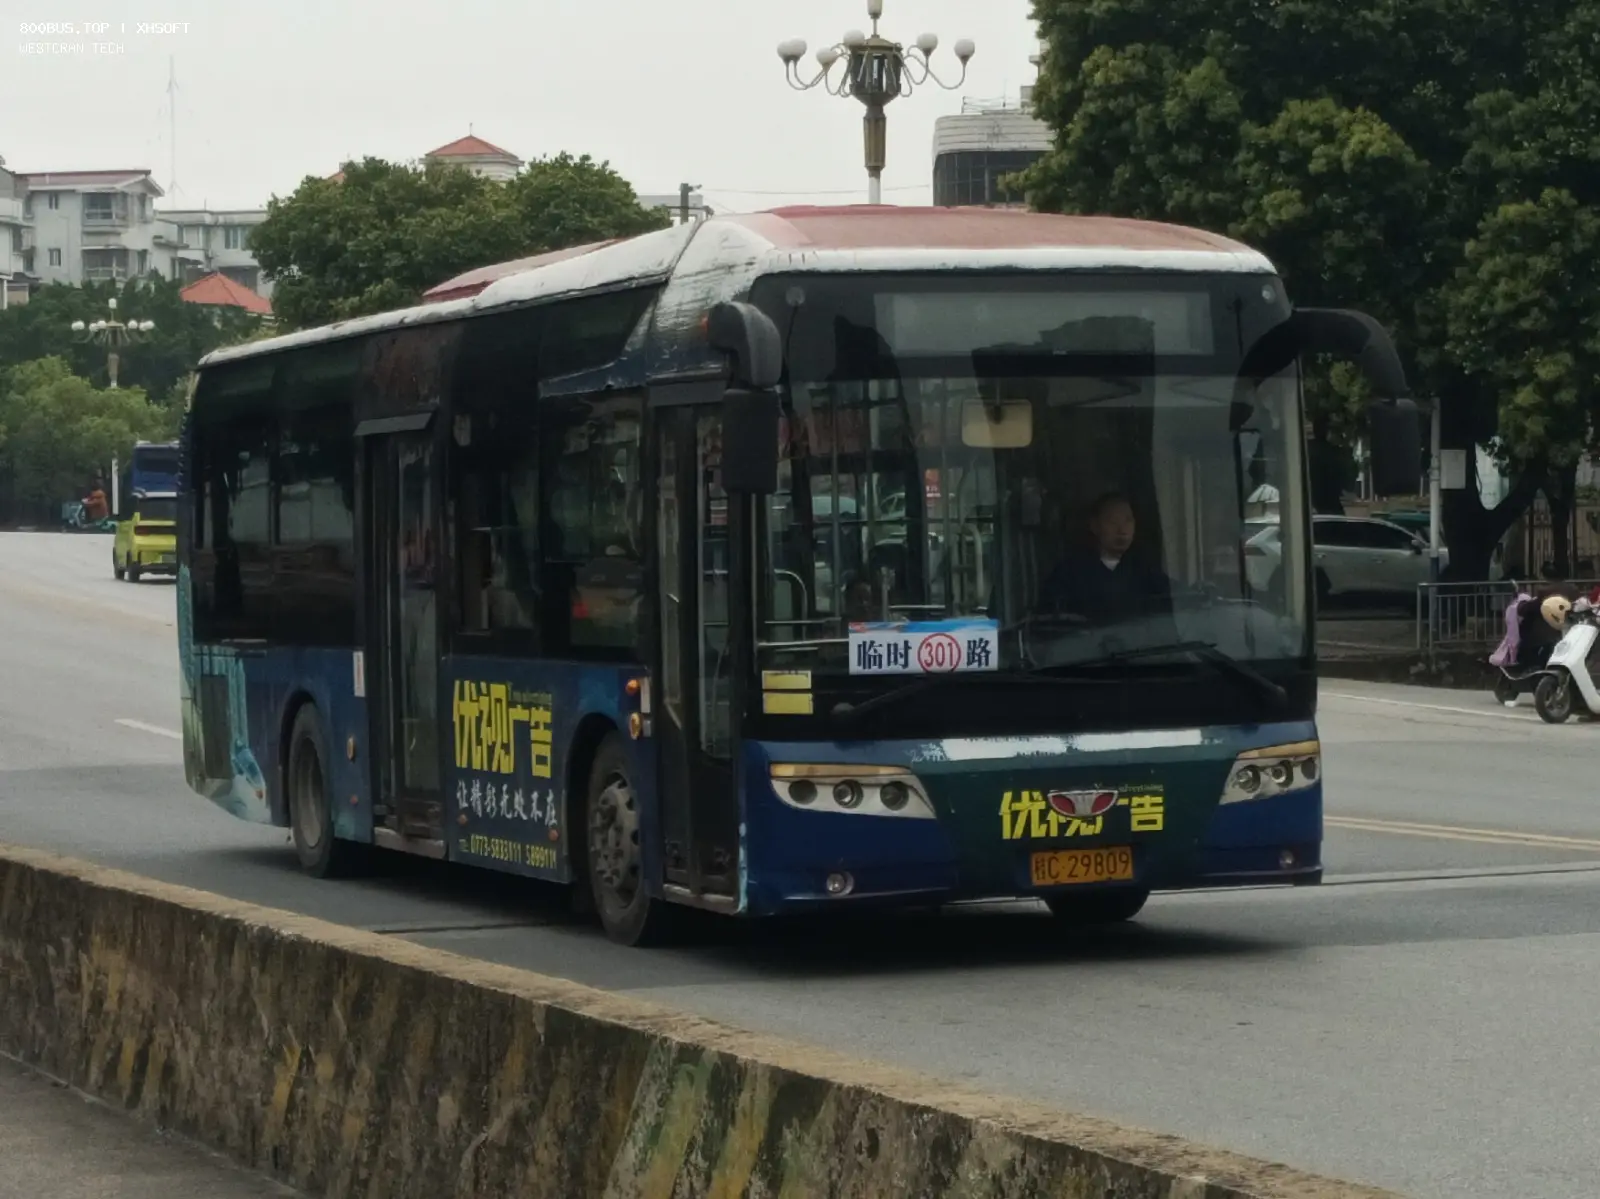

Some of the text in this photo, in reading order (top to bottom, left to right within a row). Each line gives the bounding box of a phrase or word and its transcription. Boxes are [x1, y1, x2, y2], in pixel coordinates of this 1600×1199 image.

[453, 680, 552, 778] 优视广告
[456, 779, 558, 828] 让精彩无处不在
